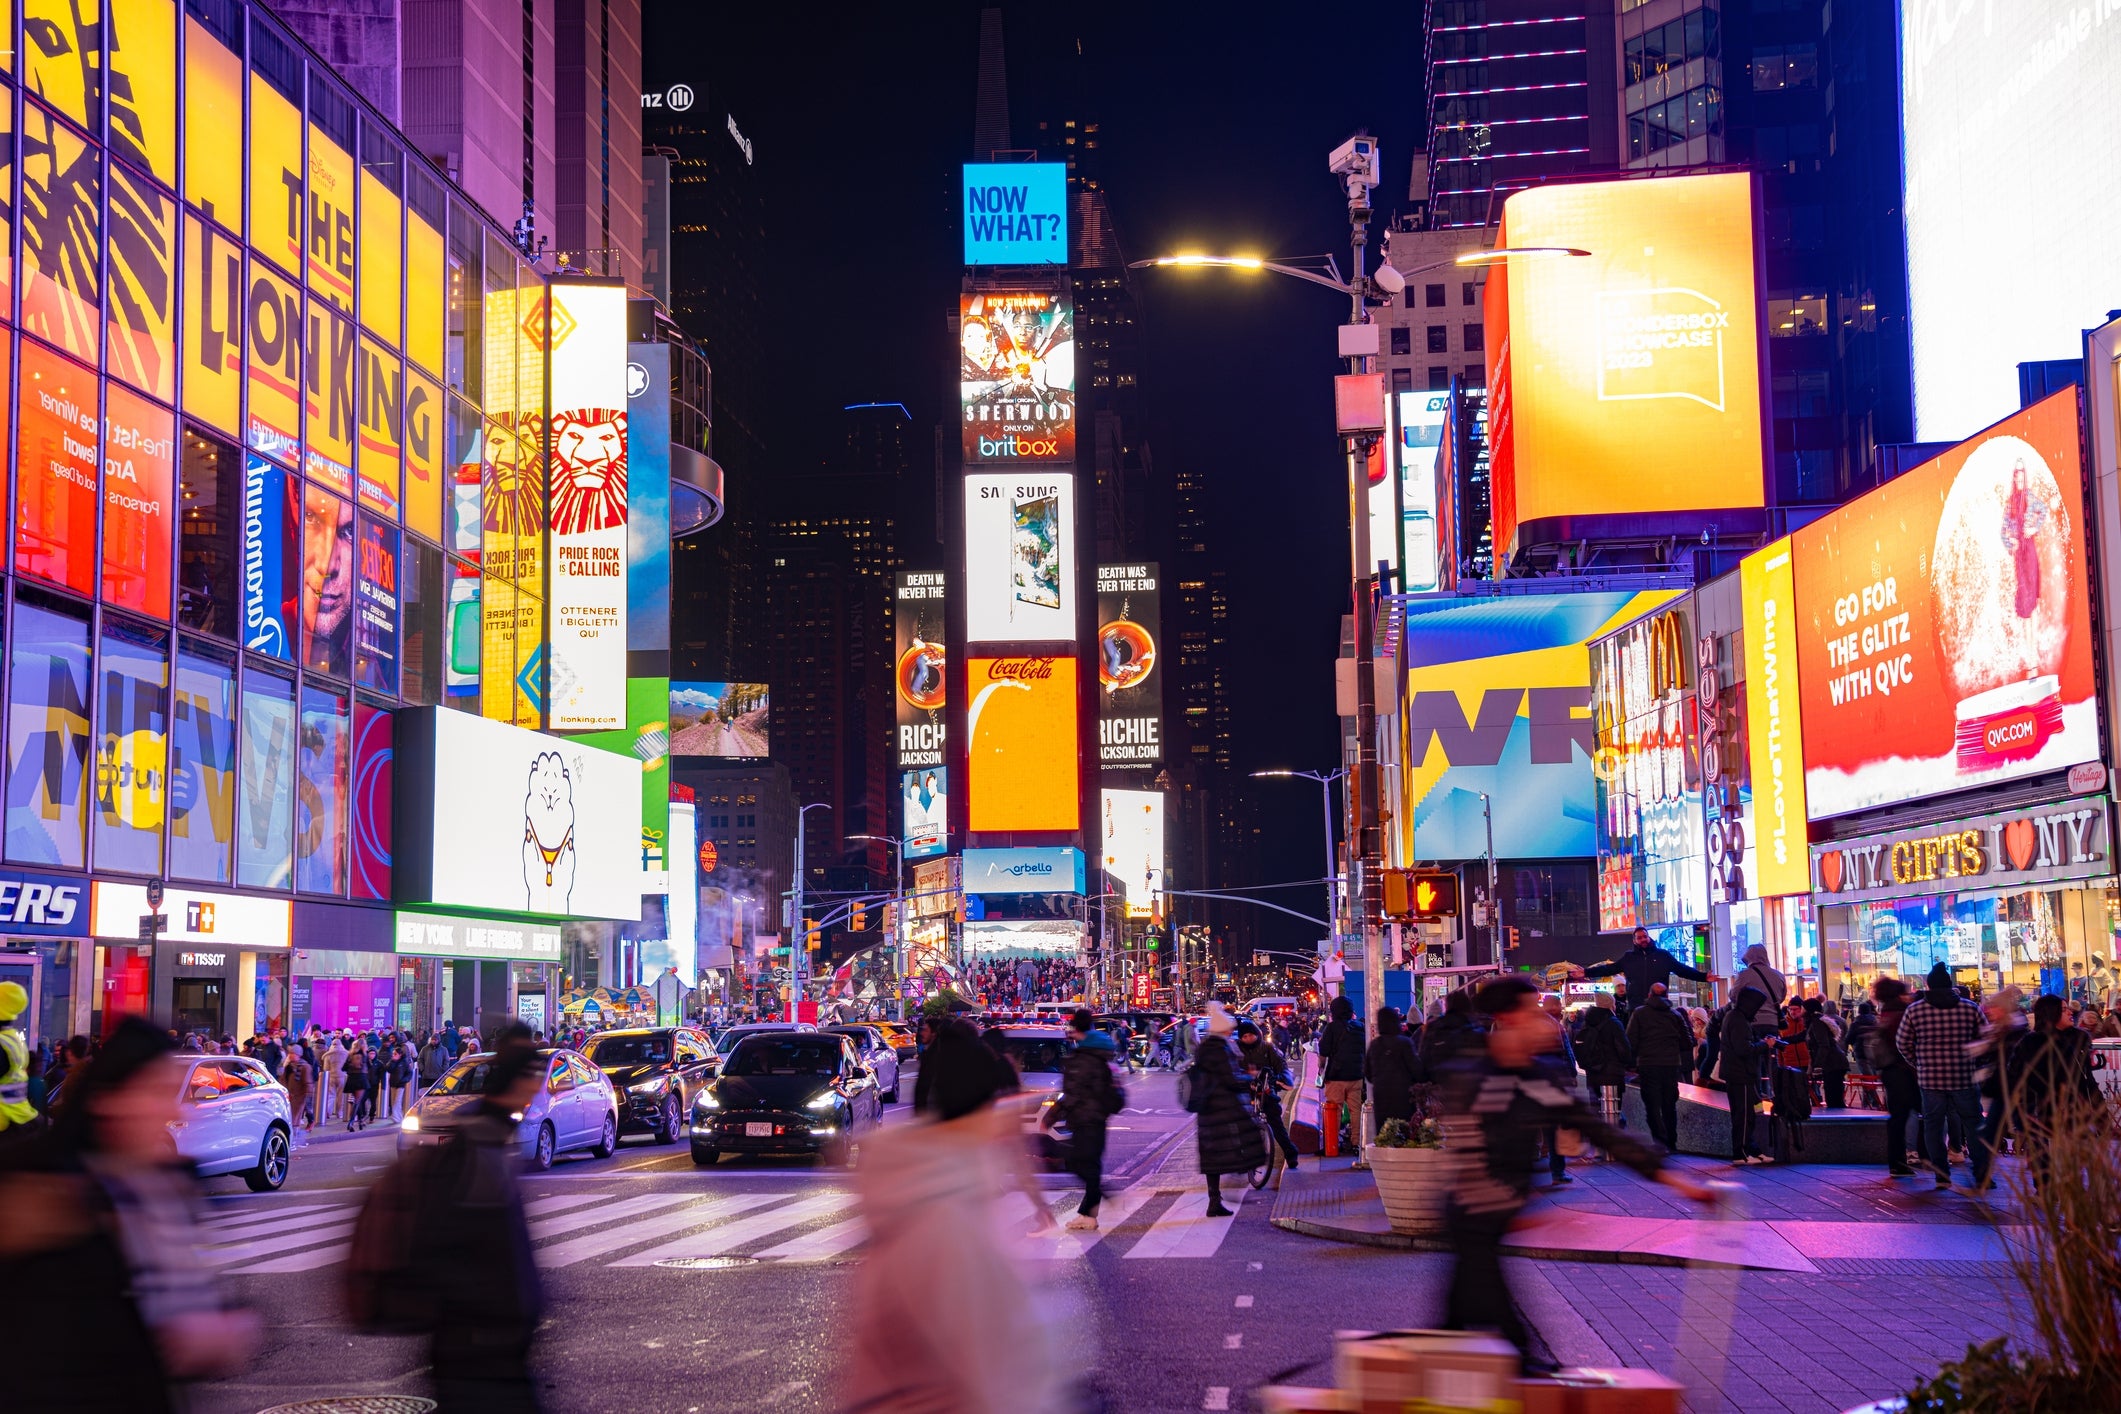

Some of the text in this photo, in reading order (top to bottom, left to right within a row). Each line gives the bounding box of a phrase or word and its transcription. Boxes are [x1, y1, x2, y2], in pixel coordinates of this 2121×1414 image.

[969, 186, 1028, 213] NOW
[283, 166, 352, 281] THE
[970, 214, 1061, 242] WHAT?
[201, 197, 320, 396] LION
[329, 293, 430, 461] KING
[967, 404, 1071, 421] SHERWOOD
[979, 434, 1058, 457] britbox
[310, 452, 323, 471] ON
[328, 462, 348, 483] 45TH
[359, 478, 382, 501] STREET
[981, 486, 1058, 499] SASUNG
[559, 546, 620, 560] PRIDE ROCK
[559, 561, 620, 577] IS CALLING
[1099, 566, 1146, 580] DEATH WAS
[907, 573, 945, 587] DEATH W
[1122, 579, 1136, 591] THE
[1137, 578, 1156, 590] END
[899, 586, 945, 600] NEVER THE
[1834, 576, 1898, 627] GO FOR
[560, 606, 617, 616] OTTENERE
[566, 617, 618, 627] BIGLIETTI
[579, 628, 599, 638] QUI
[1827, 611, 1911, 669] THE GLITZ
[1829, 653, 1913, 706] WITH QVC
[560, 716, 617, 724] lionking.com
[1988, 720, 2033, 748] QVC.COM
[900, 752, 942, 765] JACKSON
[2071, 767, 2103, 788] Heritage
[1892, 830, 1983, 884] GIFTS
[195, 953, 226, 966] TISSOT
[1137, 974, 1148, 997] tkts
